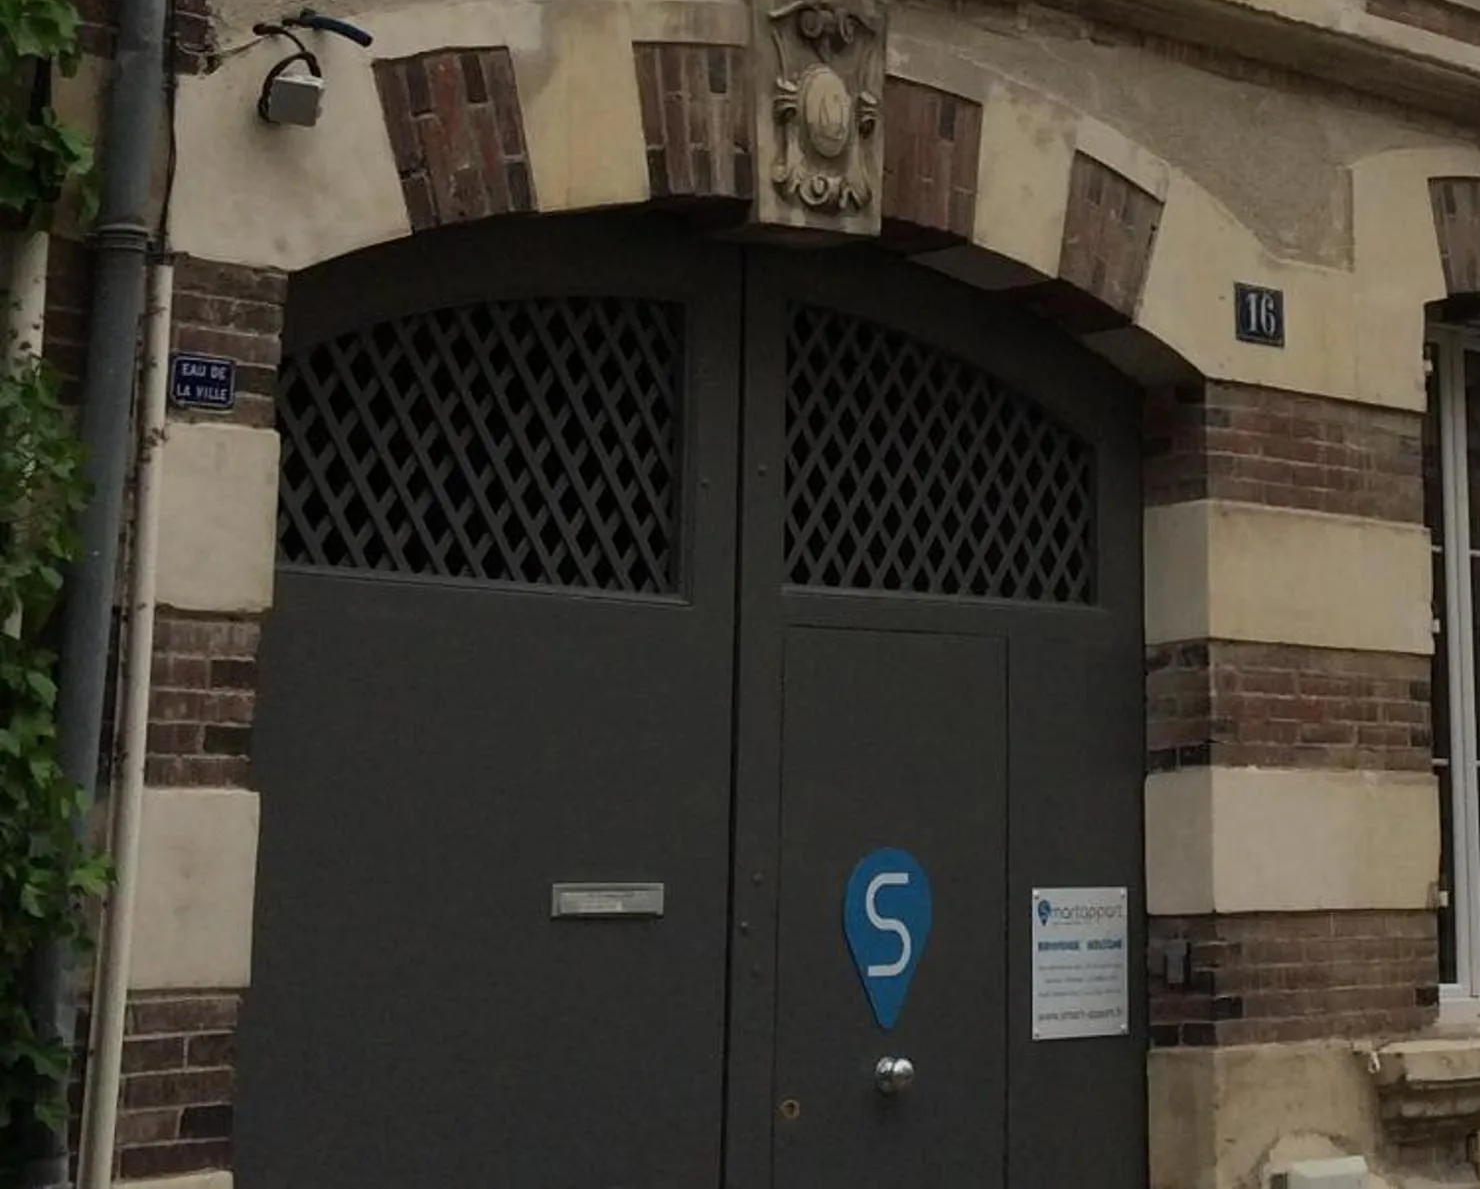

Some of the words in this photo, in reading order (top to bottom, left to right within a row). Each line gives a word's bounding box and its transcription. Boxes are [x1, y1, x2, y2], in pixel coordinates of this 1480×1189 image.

[1245, 293, 1276, 336] 16
[181, 363, 206, 377] EAU
[210, 365, 227, 381] DE
[176, 383, 191, 397] LA
[196, 385, 228, 401] VILLE
[866, 872, 911, 977] S
